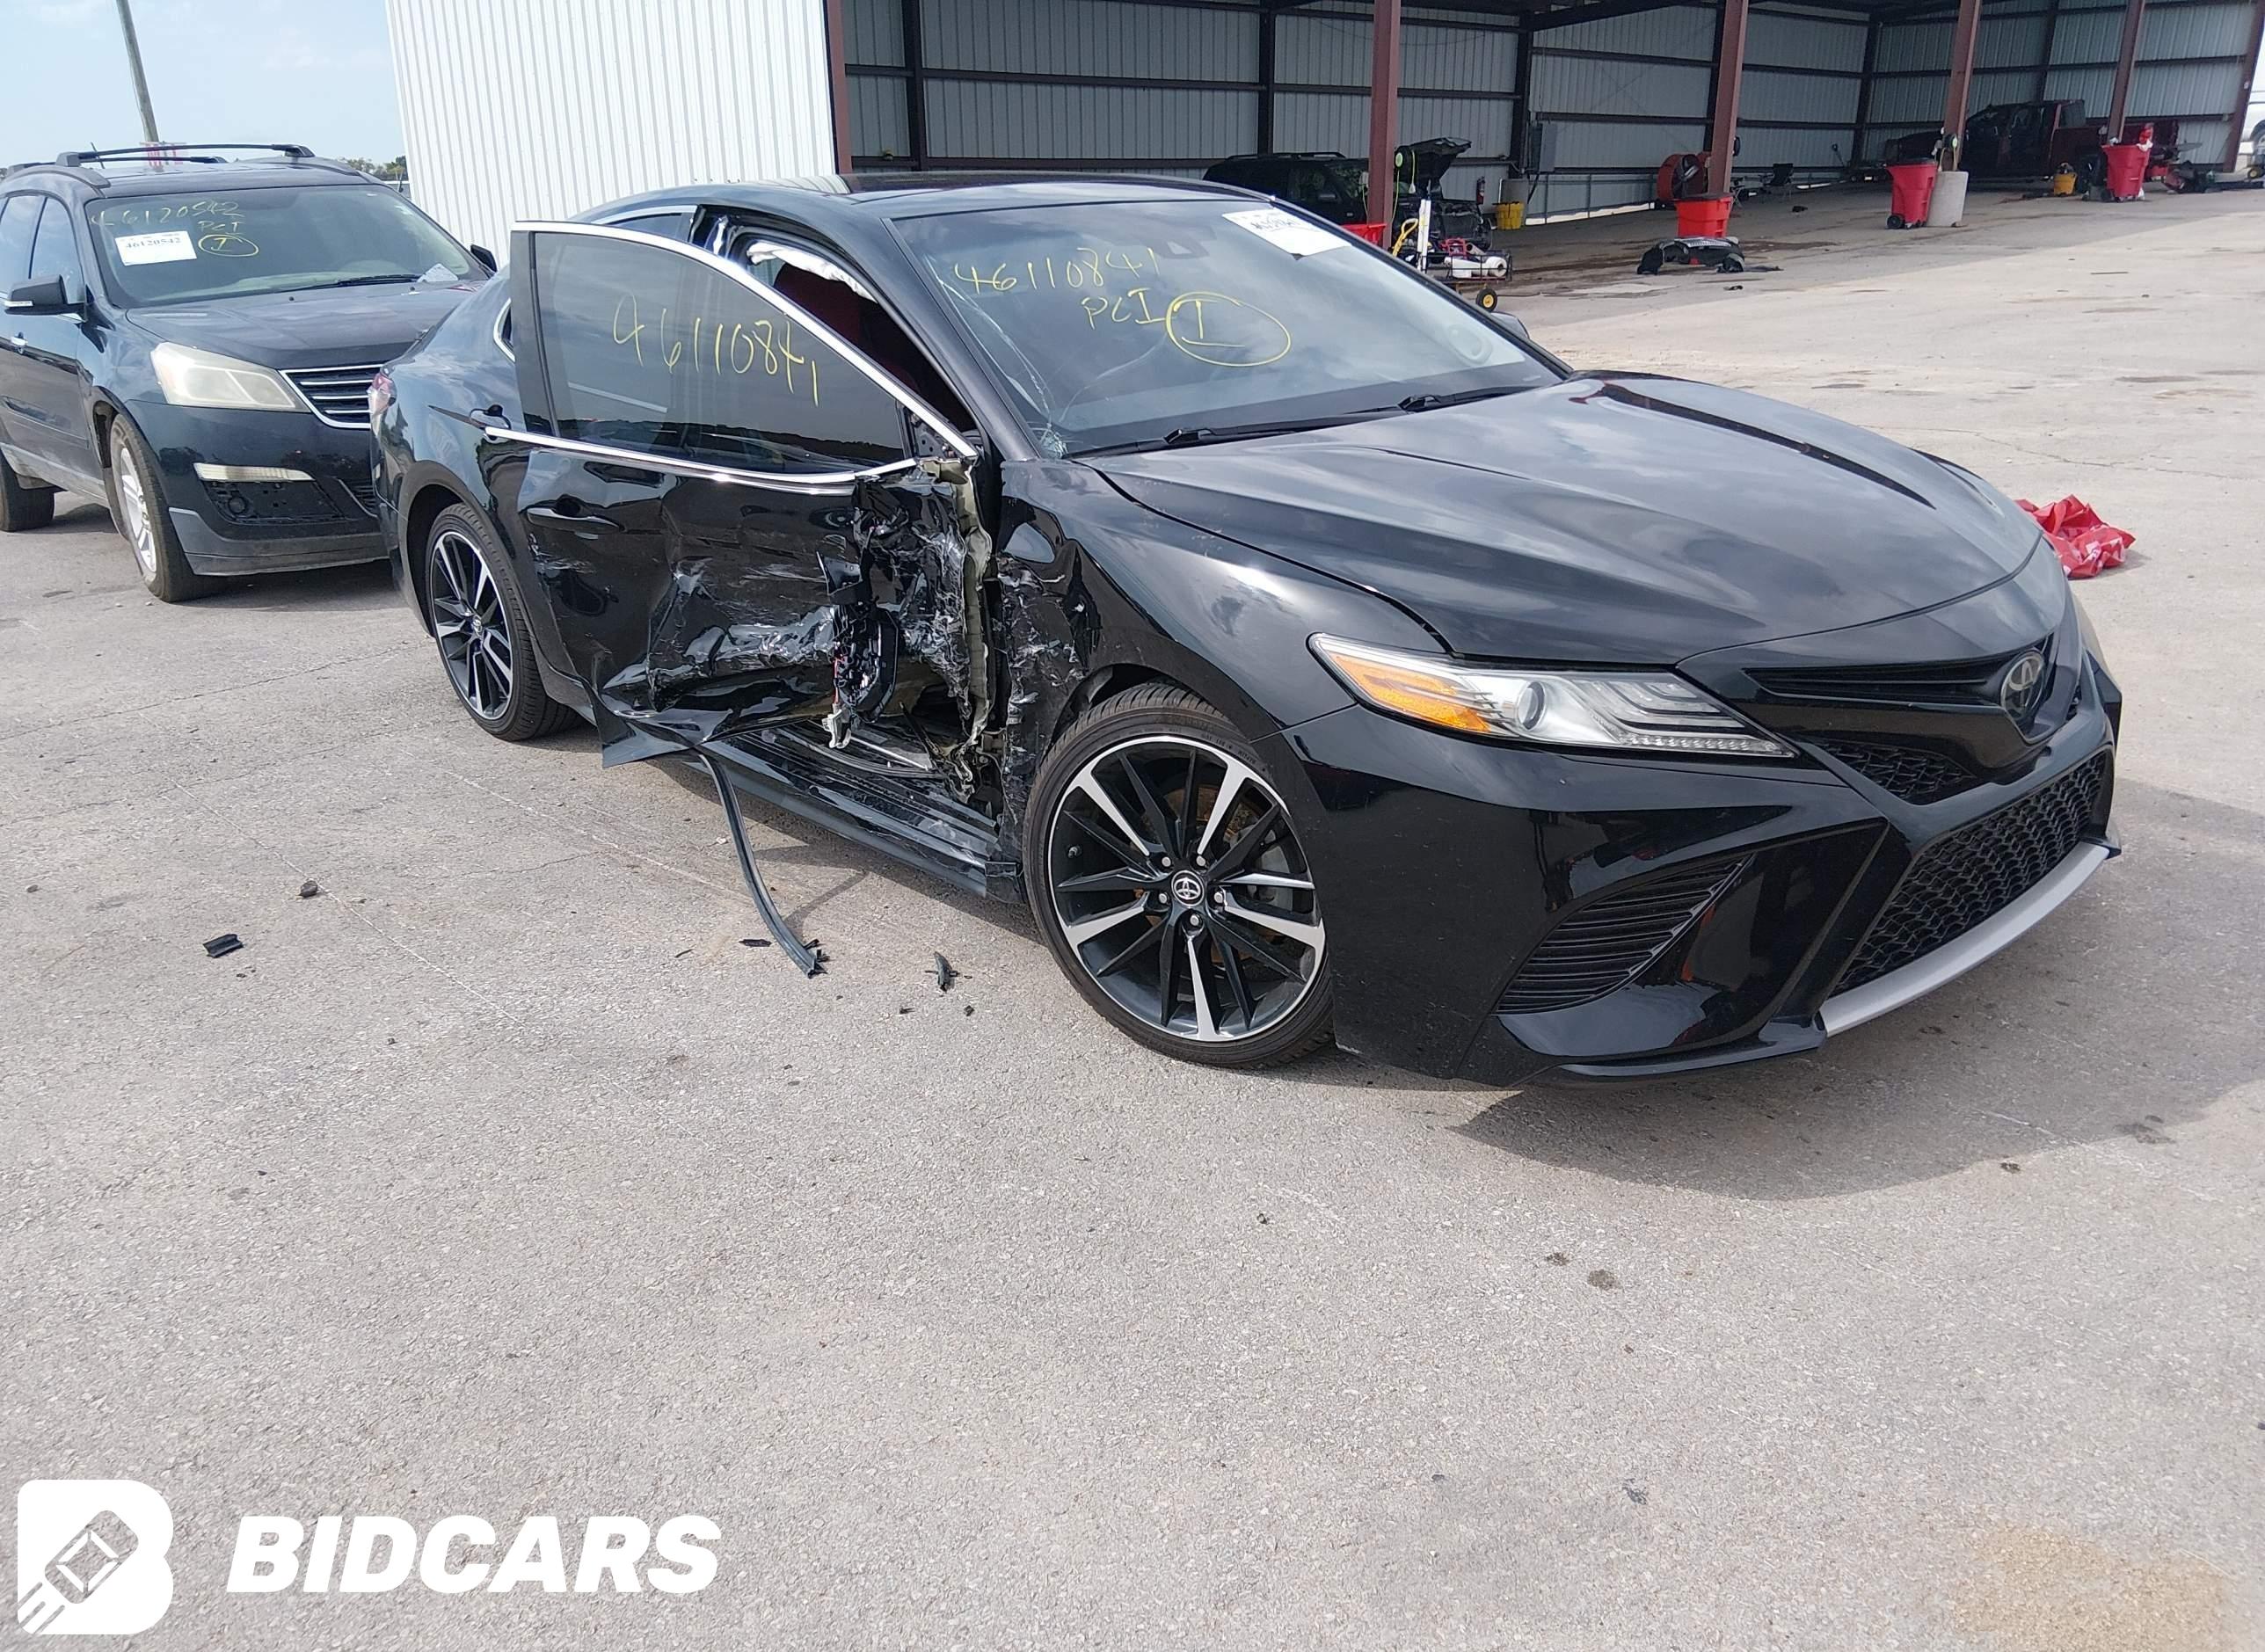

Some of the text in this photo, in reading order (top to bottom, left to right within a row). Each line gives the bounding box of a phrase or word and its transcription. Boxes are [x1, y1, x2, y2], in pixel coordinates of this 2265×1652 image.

[955, 248, 1161, 295] 46110841
[1081, 287, 1168, 331] PCI
[613, 293, 819, 408] 46110841
